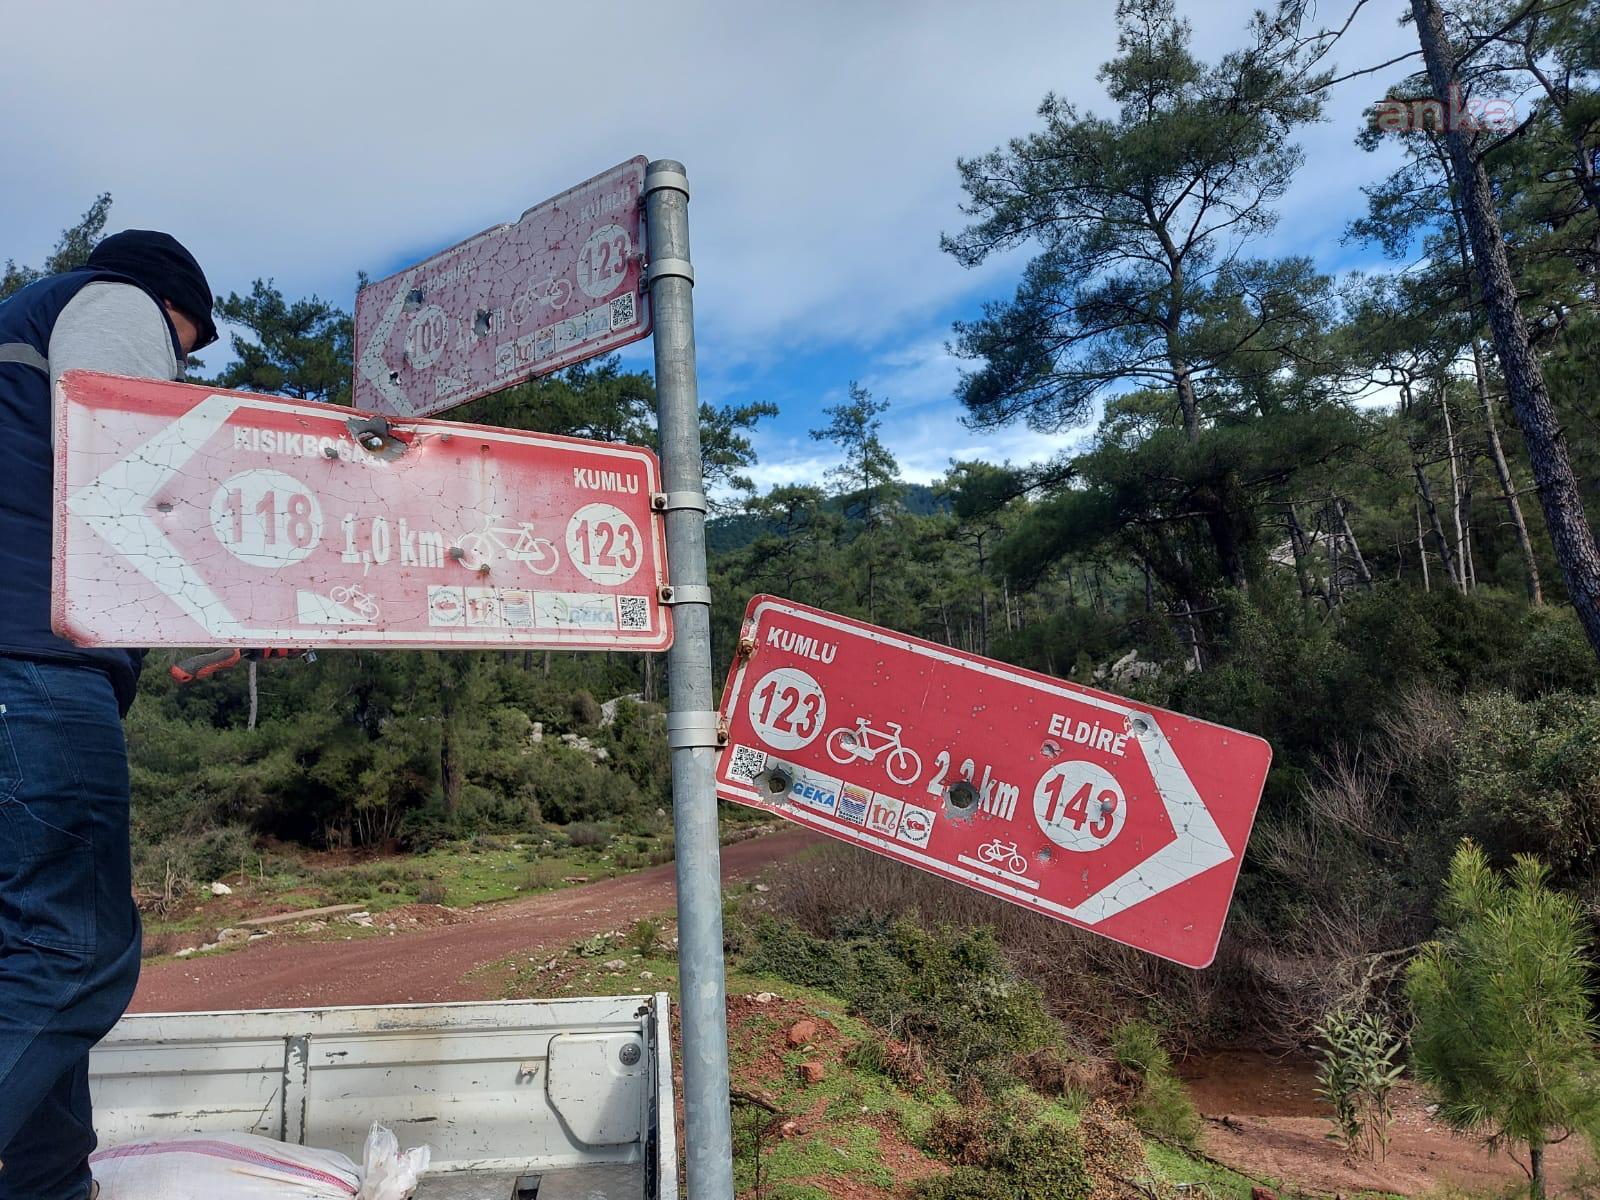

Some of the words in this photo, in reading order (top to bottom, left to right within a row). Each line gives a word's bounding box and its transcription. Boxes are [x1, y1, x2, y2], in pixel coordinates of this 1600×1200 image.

[588, 236, 627, 285] 123
[414, 314, 443, 359] 109
[573, 467, 639, 494] KUMLU
[222, 487, 313, 549] 118
[340, 512, 391, 577] 1,0
[399, 517, 445, 568] km
[575, 519, 638, 569] 123
[766, 626, 838, 665] KUMLU
[759, 680, 821, 739] 123
[1047, 713, 1128, 757] ELDİRE
[793, 782, 836, 808] GEKA
[978, 764, 1020, 821] km
[1042, 773, 1118, 839] 143
